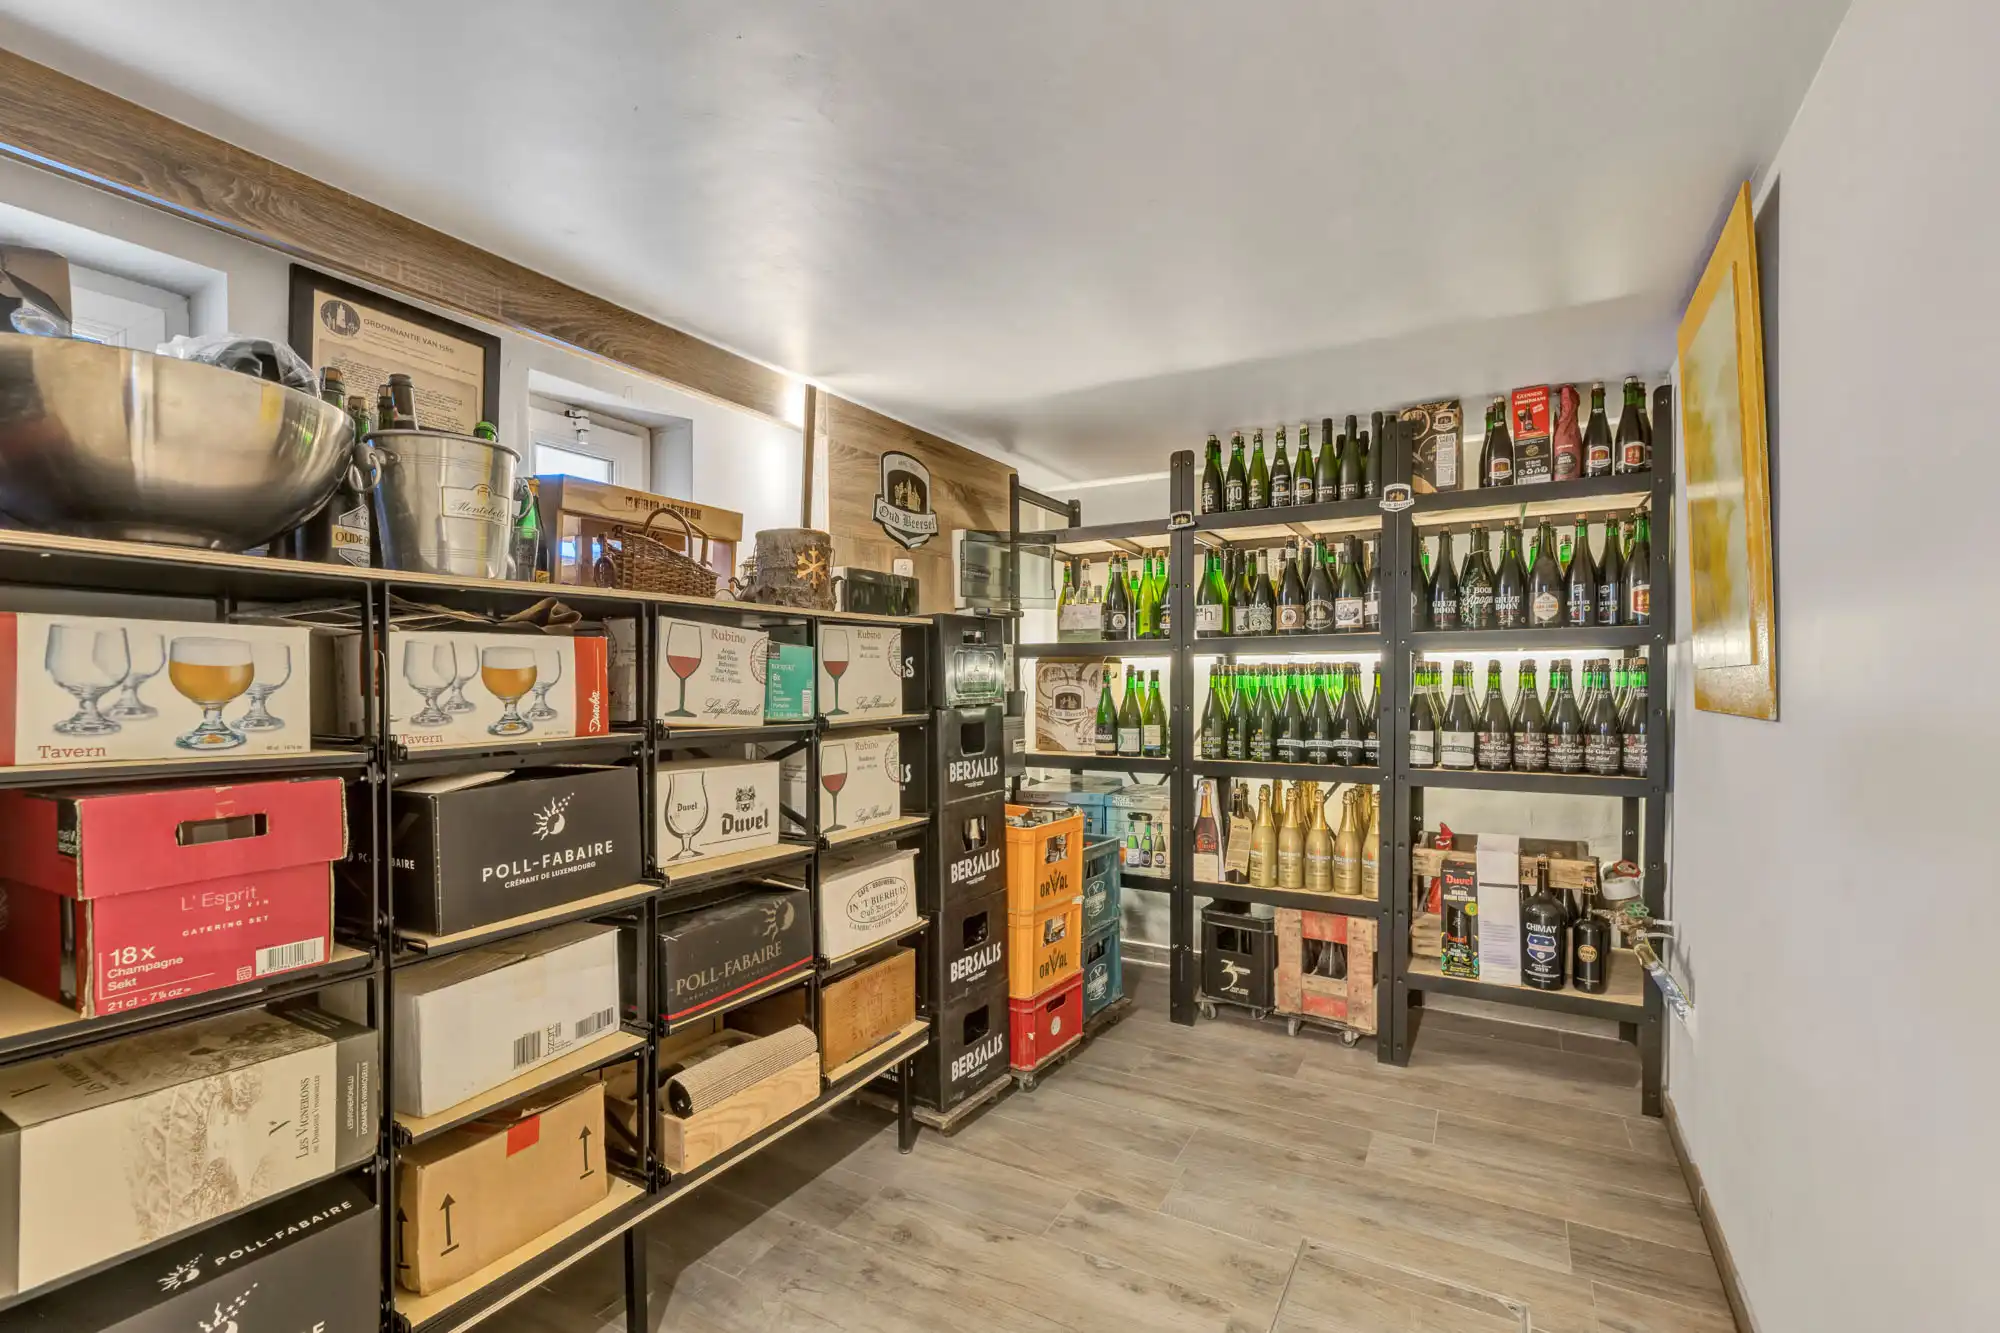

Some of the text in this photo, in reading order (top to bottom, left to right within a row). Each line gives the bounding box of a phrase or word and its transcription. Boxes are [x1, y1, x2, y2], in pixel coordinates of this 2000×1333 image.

[363, 317, 421, 344] ORDONNANTIE
[422, 337, 438, 348] VAN
[879, 505, 935, 530] Oud Beersel
[335, 531, 364, 544] OUDE
[1495, 602, 1518, 611] BOON
[711, 628, 747, 644] Rubino
[857, 629, 882, 640] Rubino
[37, 744, 107, 759] Tavern
[401, 733, 443, 747] Tavern
[950, 756, 999, 783] BERSALIS
[677, 802, 698, 812] Duvel
[721, 809, 769, 836] Duvel
[482, 840, 615, 883] POLL-FABAIRE
[951, 848, 1000, 884] BERSALIS
[505, 860, 596, 889] CRÉMANT DE LUXEMBOURG
[1040, 871, 1069, 898] ORVAL
[1445, 874, 1474, 886] Duvel
[870, 884, 907, 906] BIERHUIS
[182, 914, 269, 937] CATERING SET
[1526, 922, 1557, 934] CHIMAY
[107, 956, 184, 979] Champagne
[676, 941, 782, 996] POLL-FABAIRE
[950, 942, 1002, 984] BERSALIS
[1039, 951, 1068, 979] ORVAL
[107, 978, 137, 992] Sekt
[107, 1001, 123, 1012] 21
[126, 997, 137, 1007] cl
[952, 1033, 1004, 1082] BERSALIS
[295, 1077, 310, 1160] LES VIGNERONS
[214, 1200, 353, 1266] POLL-FABAIRE
